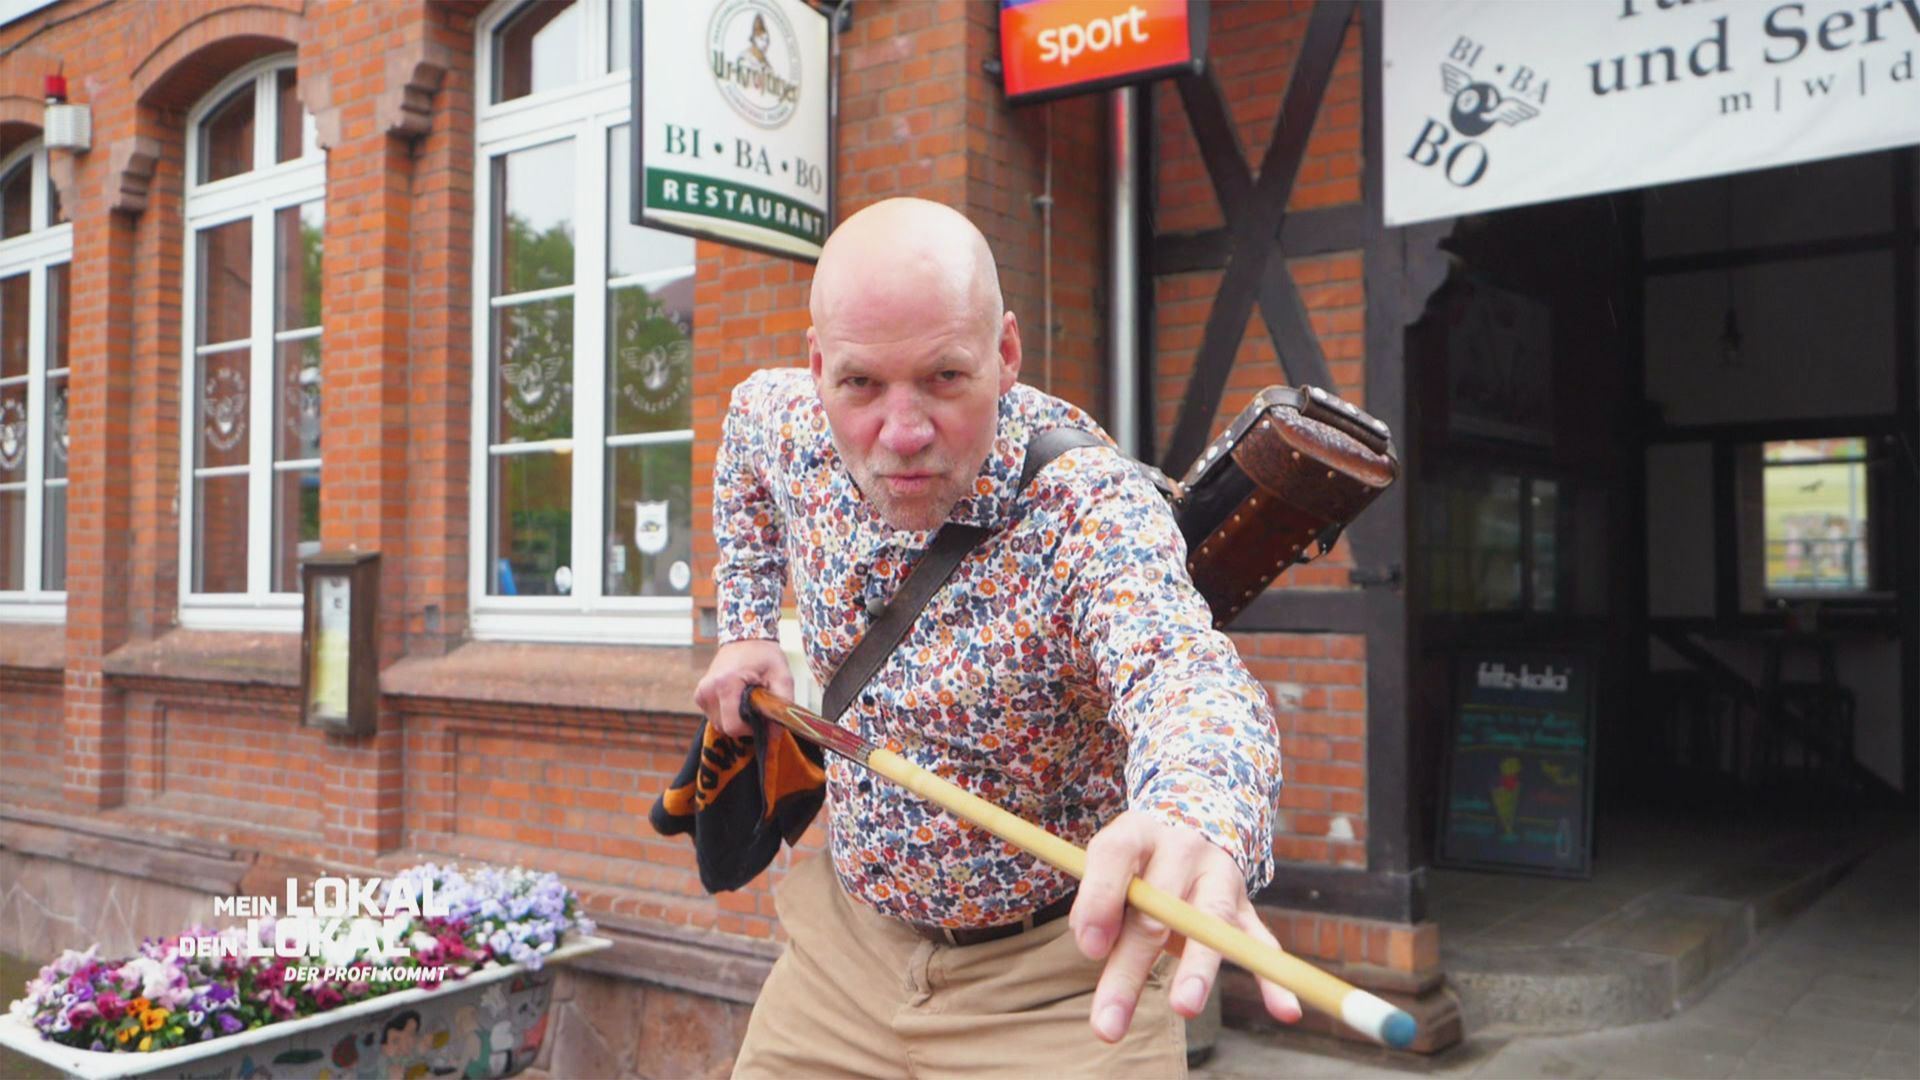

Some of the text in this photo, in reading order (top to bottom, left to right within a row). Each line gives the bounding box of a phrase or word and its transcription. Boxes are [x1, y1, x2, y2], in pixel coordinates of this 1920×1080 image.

[1037, 6, 1149, 66] sport
[1449, 35, 1549, 104] BI BA
[1586, 15, 1734, 96] und
[1719, 91, 1752, 115] m
[1803, 73, 1836, 97] w
[1890, 50, 1914, 82] d
[664, 123, 822, 195] BI BA BO
[1406, 116, 1488, 187] BO
[662, 178, 822, 237] RESTAURANT
